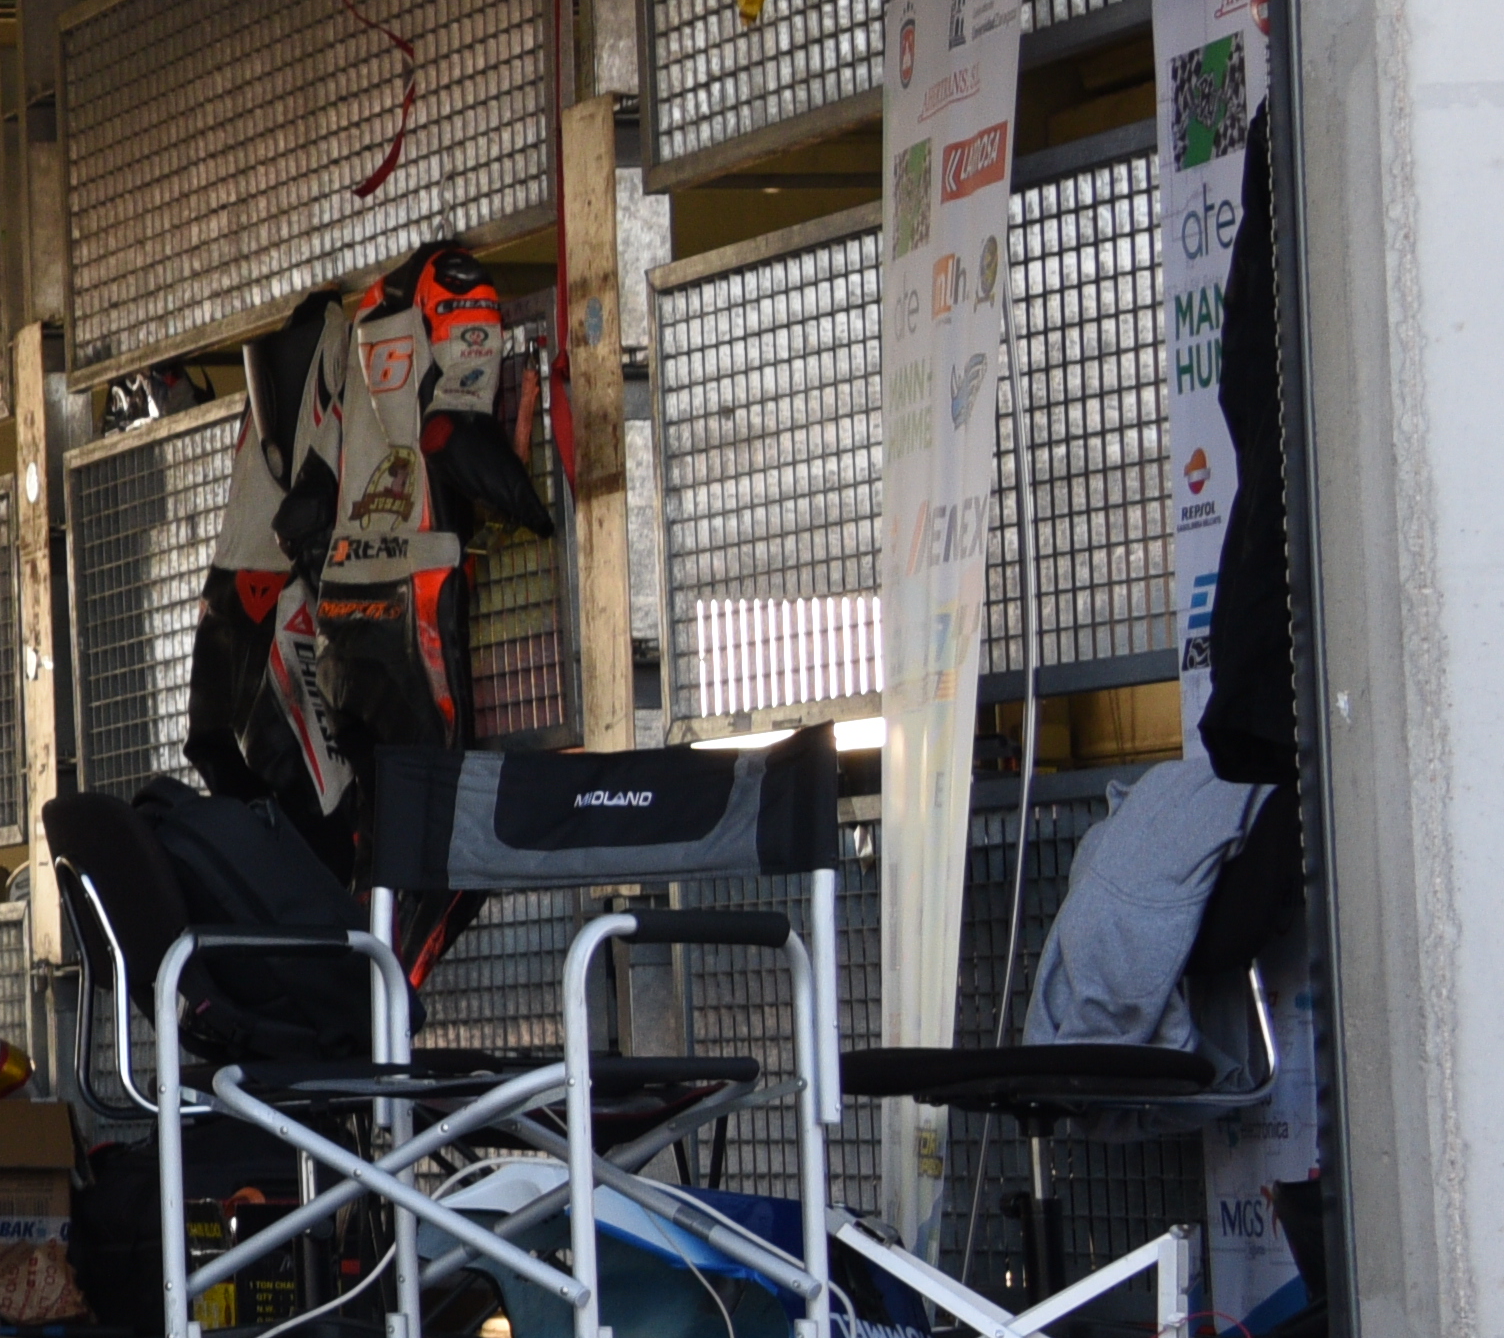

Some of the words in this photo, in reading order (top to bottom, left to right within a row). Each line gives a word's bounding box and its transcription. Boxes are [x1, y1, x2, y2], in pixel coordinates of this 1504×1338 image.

[1182, 501, 1215, 521] REPSOL
[574, 791, 652, 808] MIDLAND
[1220, 1200, 1264, 1238] MGS
